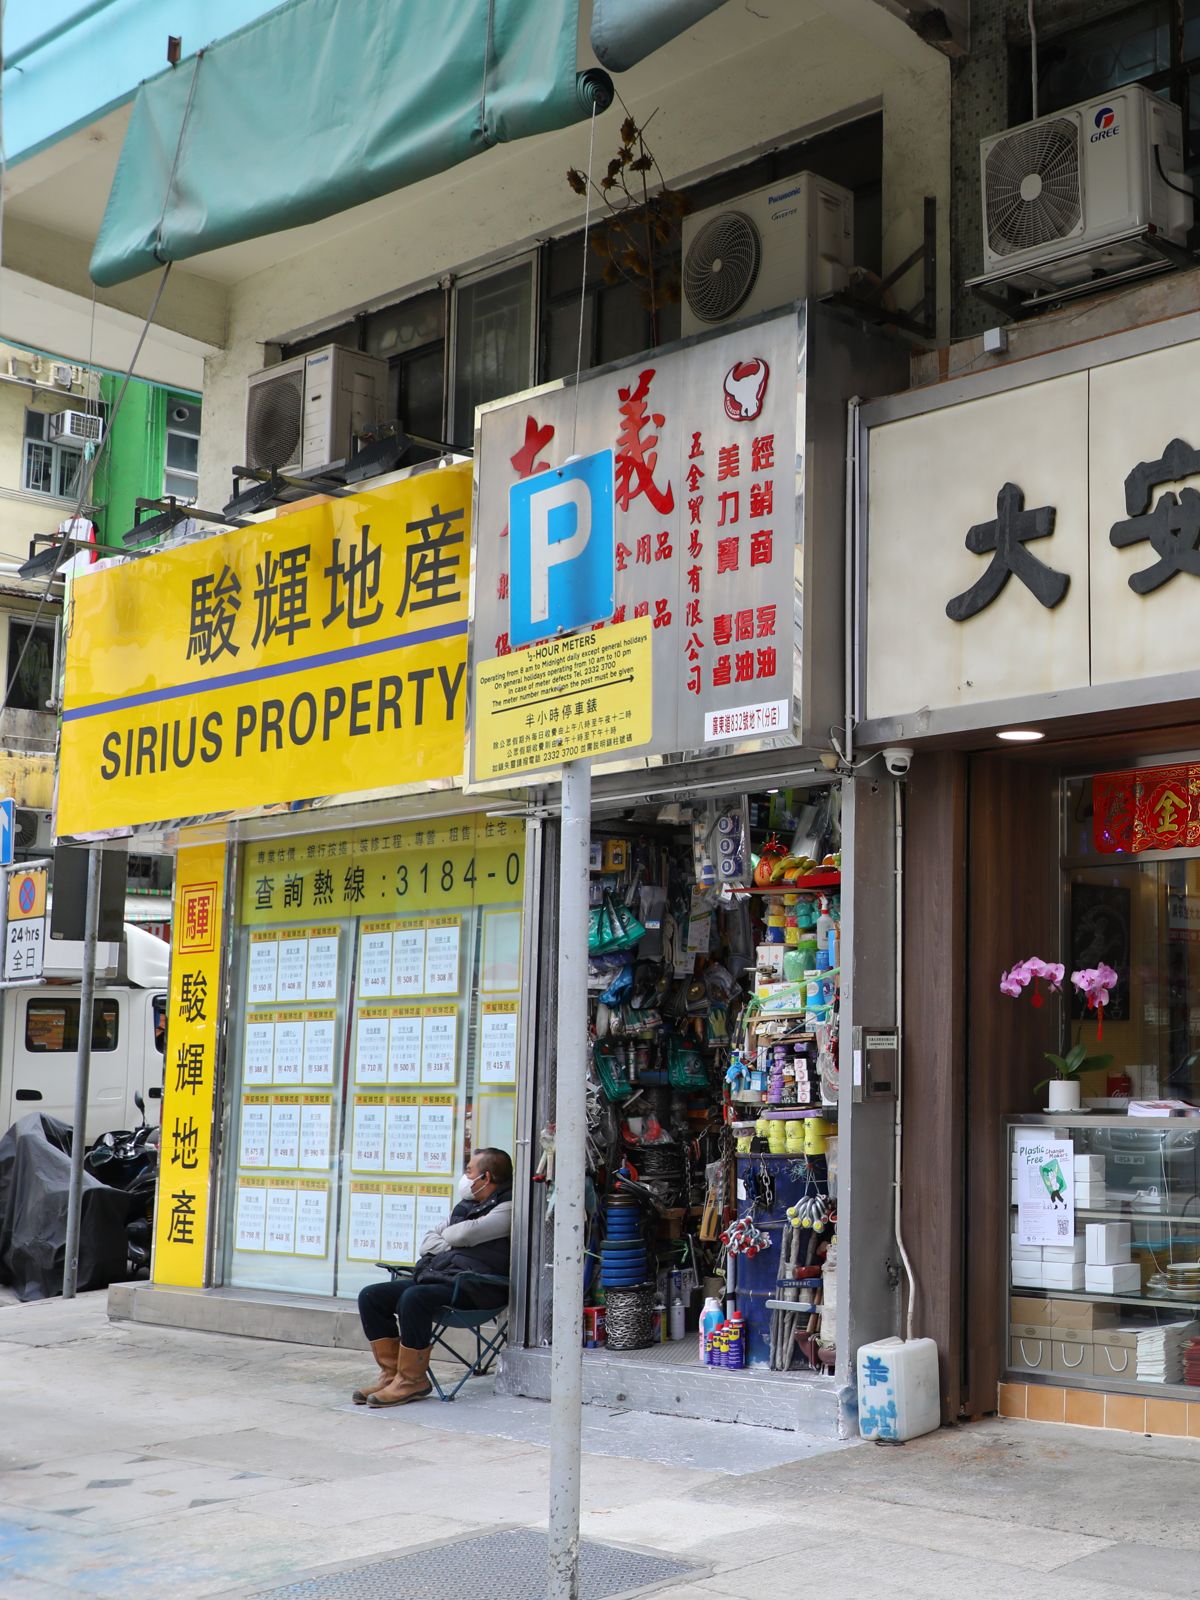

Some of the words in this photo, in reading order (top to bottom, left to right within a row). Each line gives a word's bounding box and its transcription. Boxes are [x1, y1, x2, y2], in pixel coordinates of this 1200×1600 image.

[1090, 124, 1120, 145] GREE
[717, 443, 740, 575] 美力寶
[750, 433, 775, 567] 經銷商
[530, 477, 593, 625] P
[684, 431, 705, 696] 五金貿易有限公司
[480, 672, 506, 685] Operating
[506, 669, 519, 679] from
[542, 655, 566, 670] Midnight
[567, 652, 580, 664] daily
[581, 648, 600, 660] except
[601, 642, 622, 656] general
[623, 634, 648, 648] holidays
[562, 634, 596, 654] METERS
[494, 682, 502, 690] On
[502, 677, 523, 689] general
[523, 671, 546, 684] holidays
[547, 665, 573, 680] operating
[573, 660, 587, 670] from
[588, 657, 595, 665] 10
[606, 653, 613, 661] to
[614, 650, 621, 658] 10
[622, 649, 632, 660] pm
[514, 685, 527, 693] case
[535, 679, 551, 688] meter
[552, 673, 572, 684] defects
[584, 664, 600, 676] 2332
[600, 660, 616, 672] 3700
[492, 700, 502, 708] The
[502, 696, 518, 705] meter
[519, 691, 540, 702] number
[540, 686, 563, 697] marke
[570, 680, 580, 689] the
[581, 677, 593, 688] post
[594, 672, 609, 682] must
[618, 666, 634, 678] given
[101, 711, 223, 781] SIRIUS
[235, 661, 467, 759] PROPERTY
[525, 698, 598, 728] 半小時停車錶
[543, 748, 560, 762] 2332
[561, 745, 579, 758] 3700
[11, 928, 24, 943] 24
[25, 927, 40, 941] hrs
[12, 947, 36, 973] 全日
[1020, 1144, 1045, 1156] Plastic
[1026, 1155, 1044, 1165] Free
